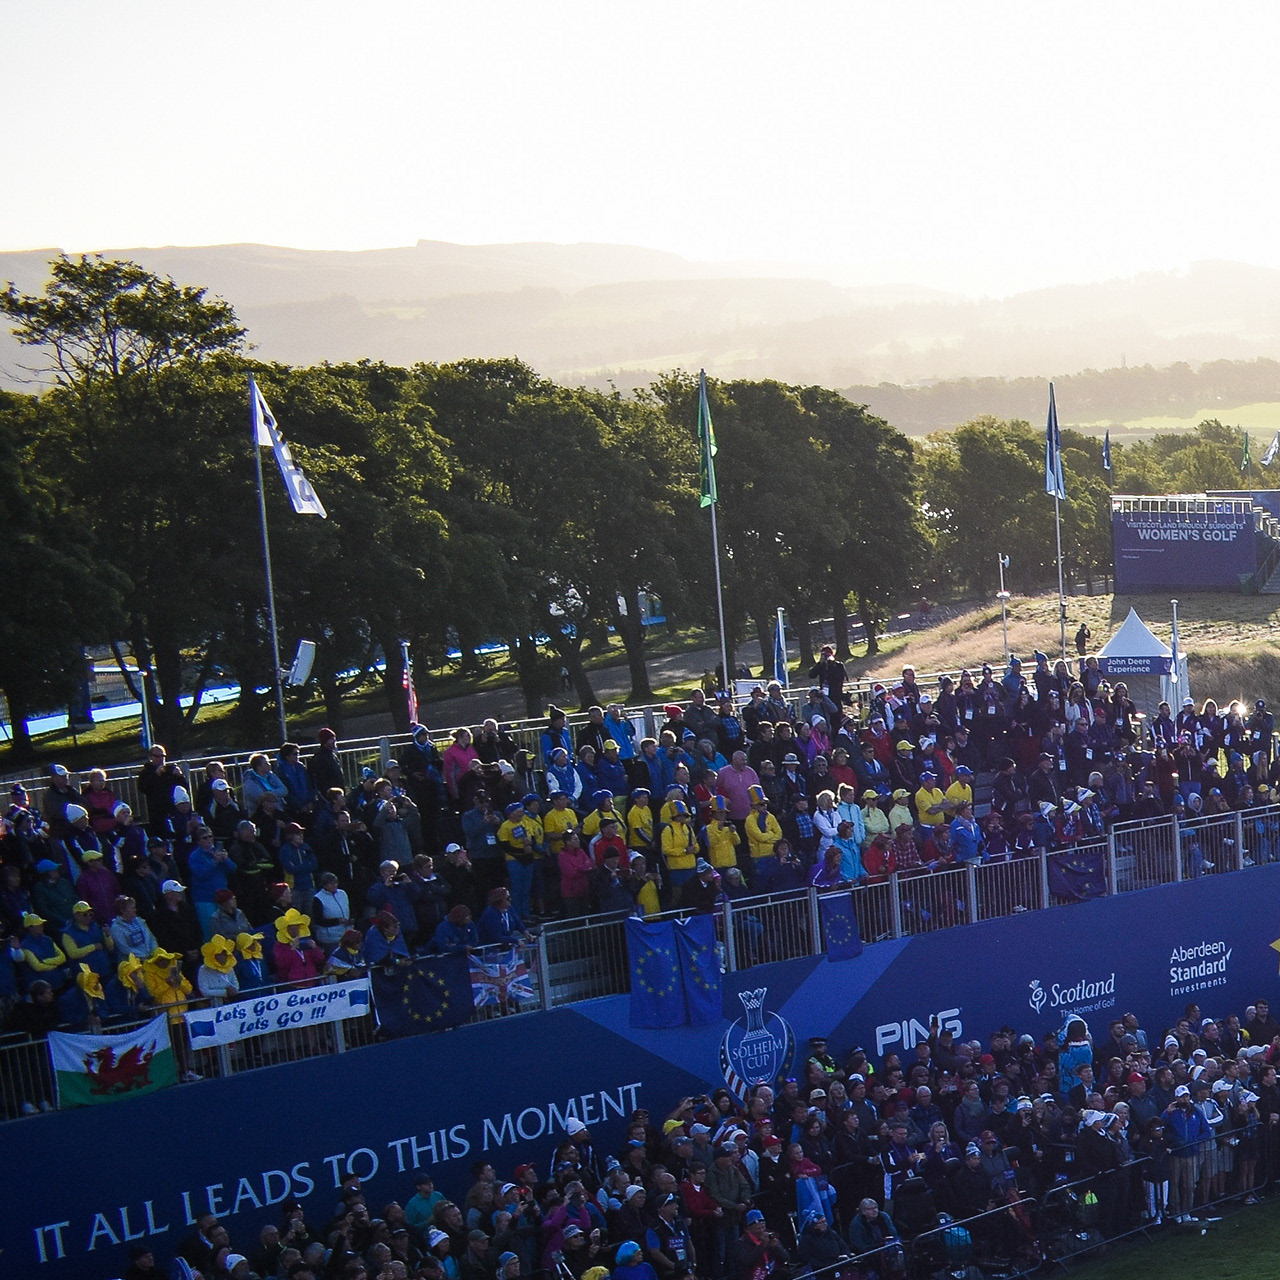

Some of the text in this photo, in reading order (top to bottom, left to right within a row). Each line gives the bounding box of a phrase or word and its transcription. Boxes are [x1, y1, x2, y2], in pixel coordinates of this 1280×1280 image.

[1138, 529, 1237, 542] WOMEN'S GOLF
[1108, 666, 1151, 674] Experience
[1170, 940, 1226, 964] Aberdeen
[1170, 955, 1226, 983] Standard
[1050, 972, 1116, 1007] Scotland
[1170, 976, 1227, 996] Investments
[253, 998, 279, 1018] GO
[287, 988, 348, 1010] Europe
[1060, 1009, 1073, 1018] The
[1074, 1004, 1093, 1016] Home
[1102, 997, 1116, 1008] Golf
[276, 1010, 303, 1028] GO
[732, 1039, 784, 1061] SOLHEIM
[746, 1054, 770, 1070] CUP
[33, 1082, 643, 1264] IT ALL LEADS TO THIS MOMENT
